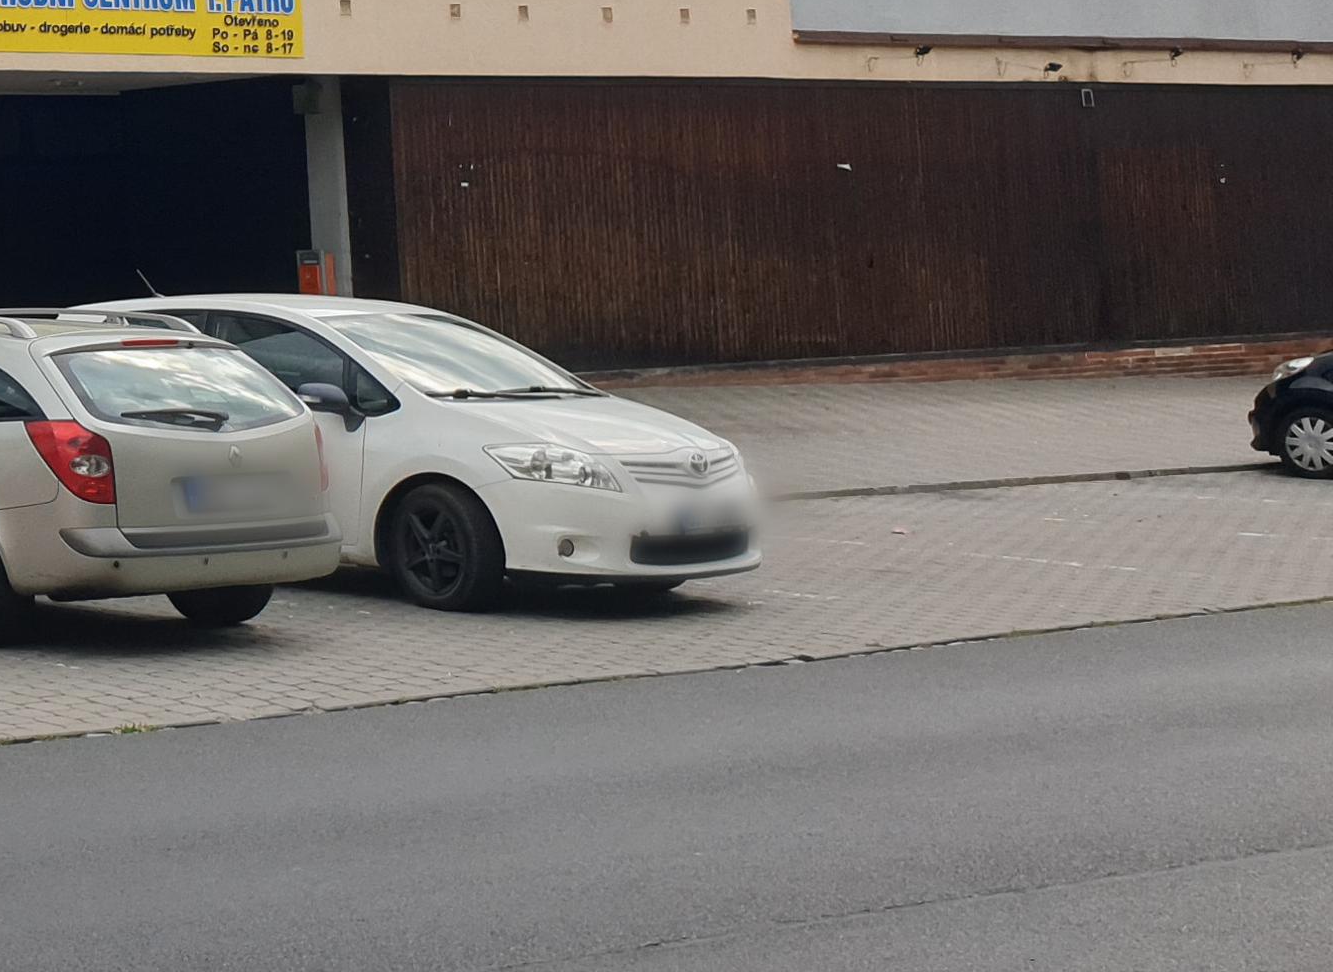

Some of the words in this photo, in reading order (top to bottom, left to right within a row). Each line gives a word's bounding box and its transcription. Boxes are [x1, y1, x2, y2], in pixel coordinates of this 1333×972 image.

[224, 14, 279, 27] Otevřeno
[39, 21, 90, 36] drogerie
[101, 23, 146, 35] domácí
[150, 24, 196, 40] potřeby
[212, 28, 228, 40] Po
[243, 29, 258, 41] Pá
[212, 41, 229, 53] So
